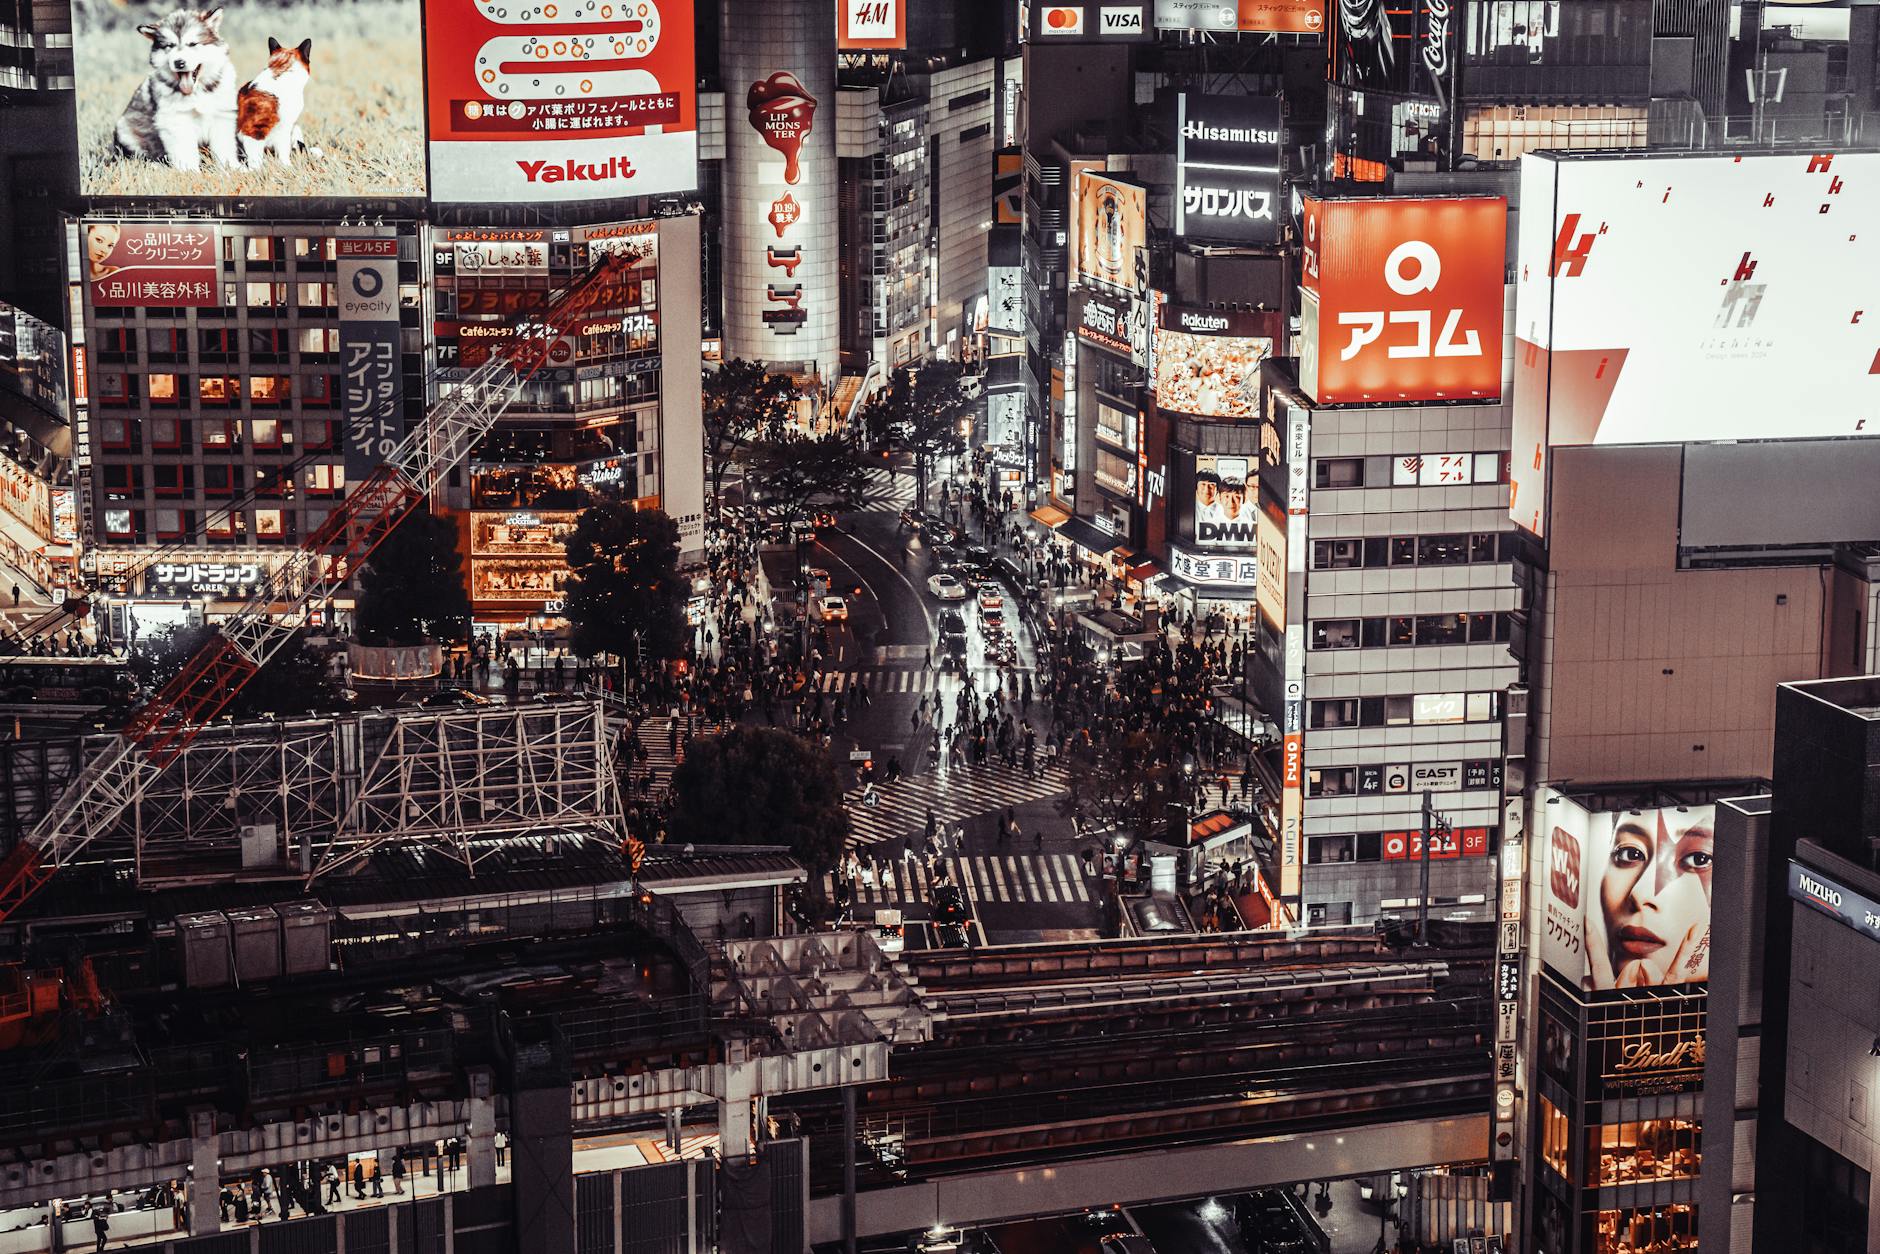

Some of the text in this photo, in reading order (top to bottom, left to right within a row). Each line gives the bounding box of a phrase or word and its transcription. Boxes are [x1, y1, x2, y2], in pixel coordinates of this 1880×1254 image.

[856, 3, 888, 25] H&M
[1104, 14, 1140, 27] VISA
[532, 115, 629, 130] 小腸に運ばれます。
[770, 113, 788, 121] LIP
[765, 121, 800, 130] MONS
[1180, 121, 1278, 144] Hisamitsu
[773, 131, 796, 139] TER
[516, 157, 636, 183] Yakult
[1184, 185, 1272, 220] サロンパス
[144, 232, 209, 247] 品川スキン
[447, 231, 543, 241] しゃぶしゃぶバイキング
[145, 248, 202, 261] クリニック
[342, 242, 390, 253] 当ビル5F
[435, 253, 452, 265] 9F
[488, 248, 542, 266] しゃぶ葉
[109, 282, 211, 299] 品川美容外科
[345, 300, 392, 315] eyecity
[622, 314, 654, 333] ガスト
[1182, 313, 1228, 329] Rakuten
[1338, 309, 1483, 361] アコム
[437, 345, 457, 359] 7F
[347, 342, 375, 456] アイシティ
[376, 342, 397, 456] コンタクトの
[156, 564, 258, 583] サンドラッグ
[1175, 554, 1256, 580] 大盛堂書店
[1420, 701, 1456, 714] レイク
[1287, 754, 1297, 781] アコム
[1416, 768, 1457, 779] EAST
[1364, 778, 1378, 790] 4F
[1286, 818, 1295, 865] プロミス
[1466, 836, 1482, 847] 3F
[1800, 873, 1842, 907] MIZUHO
[1547, 916, 1580, 954] ワクワク
[1501, 964, 1509, 994] カラオケ
[1501, 1004, 1515, 1015] 3F
[1615, 1041, 1691, 1070] Lindt
